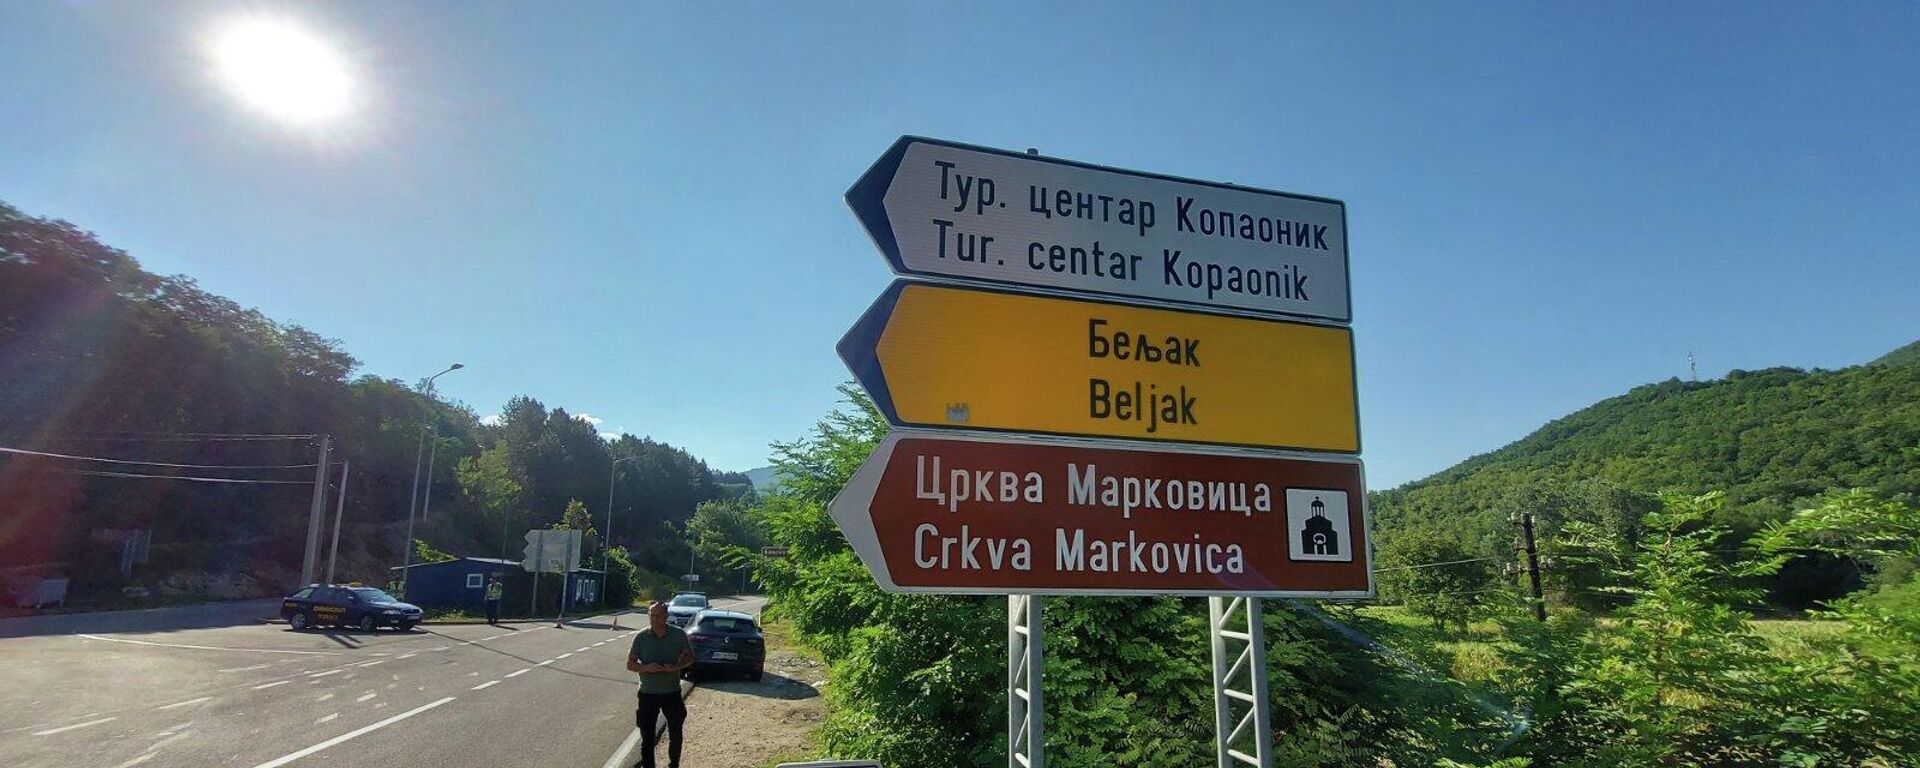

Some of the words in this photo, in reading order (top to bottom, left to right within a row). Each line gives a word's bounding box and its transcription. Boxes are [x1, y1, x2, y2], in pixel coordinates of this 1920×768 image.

[934, 160, 1006, 216] Тур.
[1029, 185, 1156, 236] центар
[1176, 197, 1329, 250] Копаоник
[932, 218, 1004, 266] Tur.
[1028, 242, 1143, 281] centar
[1163, 249, 1309, 300] Kopaonik
[1088, 318, 1201, 368] Бељак
[1089, 378, 1198, 433] Beljak
[916, 455, 1043, 513] Црква
[1067, 462, 1271, 519] Марковица
[914, 523, 1031, 571] Crkva
[1055, 528, 1244, 574] Markovica
